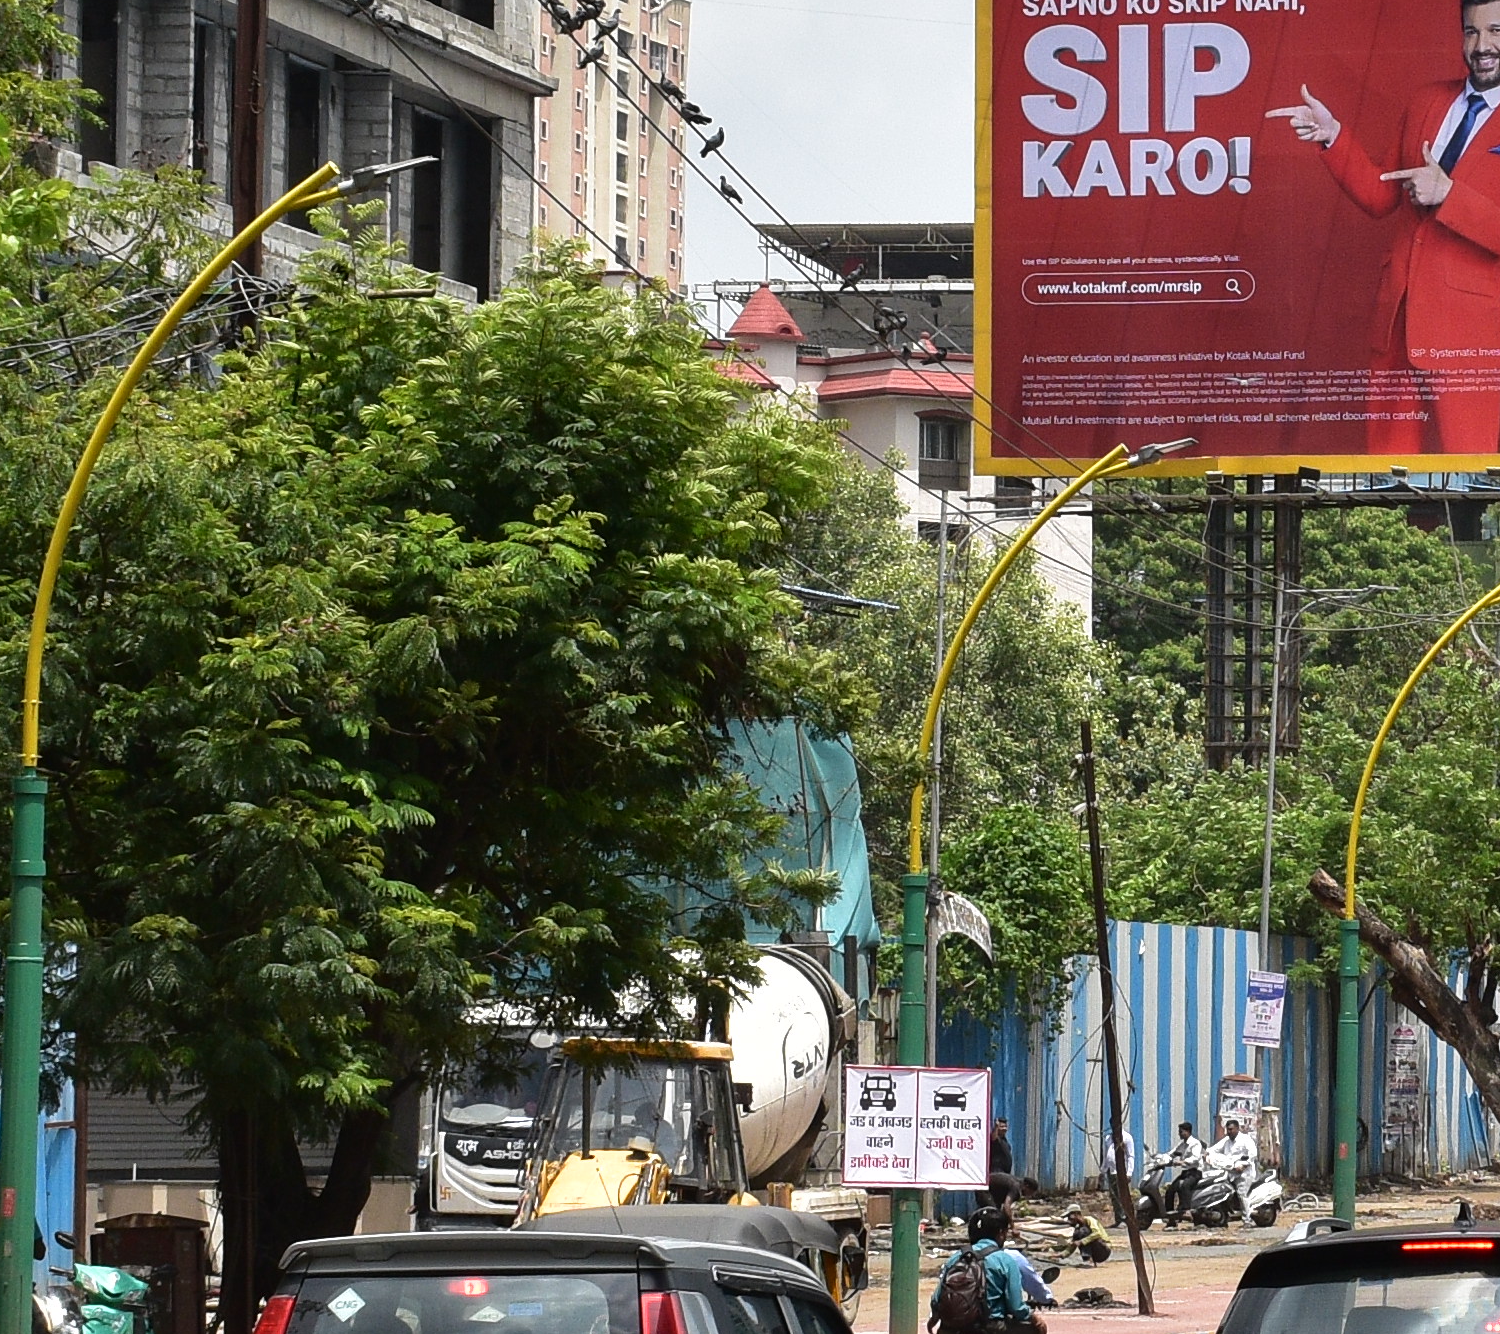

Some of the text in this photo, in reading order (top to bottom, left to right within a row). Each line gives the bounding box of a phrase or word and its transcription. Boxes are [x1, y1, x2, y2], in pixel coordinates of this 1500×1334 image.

[1021, 22, 1251, 136] SIP
[1022, 136, 1252, 198] KARO!
[1037, 279, 1202, 295] www.kotakmf.com/mrsip
[1022, 351, 1305, 363] An investor education and awareness initiative by Kotak Mutual Fund
[1430, 347, 1476, 359] Systematic
[1022, 410, 1430, 427] Mutual fund investments are subject to market risks, read all scheme related documents carefully.
[850, 1116, 912, 1128] जड व अवजड
[920, 1115, 982, 1130] हलकी वाहने
[456, 1139, 479, 1156] शुभ
[866, 1134, 894, 1149] वाहने
[926, 1135, 974, 1150] उजवी कडे
[482, 1149, 530, 1160] ASHO
[850, 1154, 911, 1169] डावीकडे ठेवा
[942, 1156, 960, 1170] ठेवा
[335, 1301, 357, 1309] CNG
